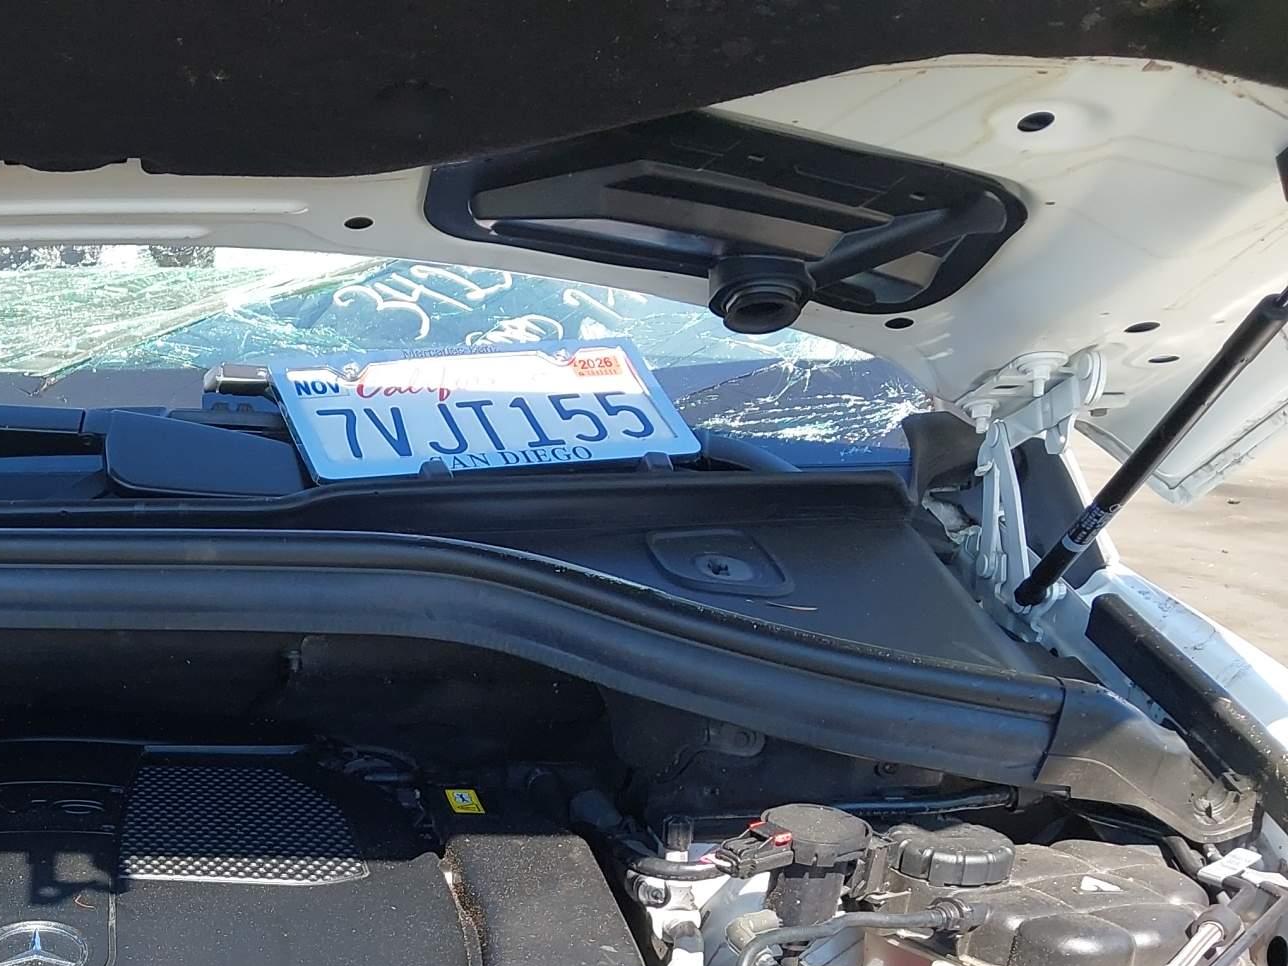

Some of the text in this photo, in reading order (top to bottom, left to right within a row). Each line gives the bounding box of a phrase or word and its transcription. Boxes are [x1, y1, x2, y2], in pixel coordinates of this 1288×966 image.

[577, 356, 613, 370] 2026
[295, 380, 340, 396] NOV
[315, 391, 655, 459] 7VJT155
[498, 445, 593, 466] DIEGO
